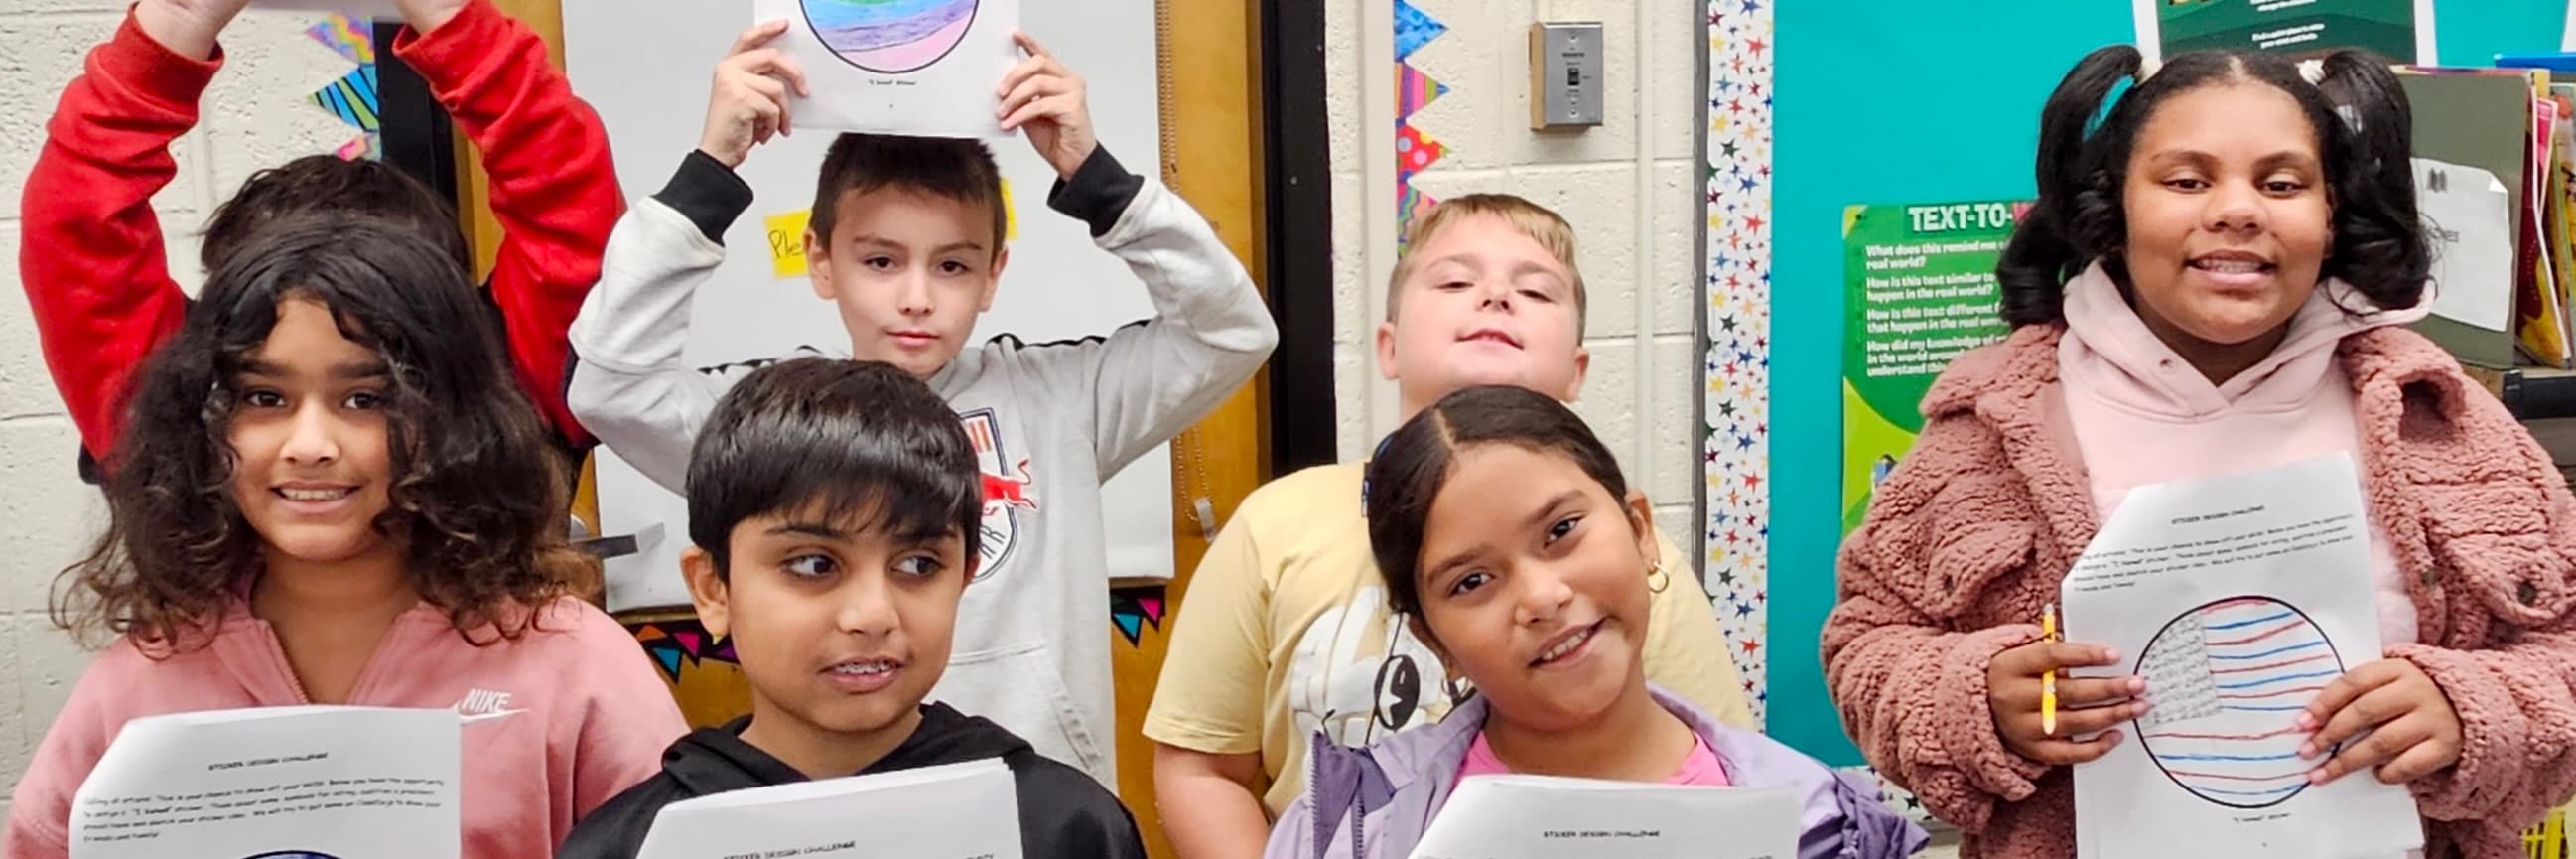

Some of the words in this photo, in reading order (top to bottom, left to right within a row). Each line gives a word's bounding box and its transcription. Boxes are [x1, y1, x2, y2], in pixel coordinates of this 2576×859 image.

[768, 229, 803, 259] Ple
[1866, 245, 1894, 257] What
[1894, 244, 1921, 256] does
[1922, 242, 1941, 254] this
[1943, 240, 1979, 253] remind
[1980, 241, 1996, 251] me
[1866, 258, 1888, 270] real
[1890, 256, 1926, 269] world?
[1866, 276, 1889, 289] How
[1891, 276, 1901, 288] is
[1902, 275, 1921, 287] this
[1923, 274, 1945, 286] text
[1946, 272, 1982, 285] similar
[1866, 290, 1904, 303] happen
[1906, 288, 1916, 299] in
[1917, 287, 1934, 299] the
[1935, 285, 1957, 297] real
[1958, 283, 1993, 296] world?
[1866, 308, 1889, 320] How
[1891, 308, 1901, 320] is
[1902, 307, 1921, 319] this
[1923, 306, 1945, 318] text
[1946, 302, 1993, 316] different
[1866, 322, 1889, 333] that
[1890, 320, 1927, 334] happen
[1929, 319, 1938, 330] in
[1939, 317, 1957, 329] the
[1958, 315, 1979, 328] real
[1866, 340, 1890, 352] How
[1891, 339, 1908, 351] did
[1909, 340, 1925, 352] my
[1926, 334, 1981, 349] knowledge
[1866, 354, 1877, 364] in
[1878, 353, 1896, 364] the
[1897, 350, 1928, 363] world
[1866, 363, 1927, 377] understand
[461, 687, 513, 713] NIKE
